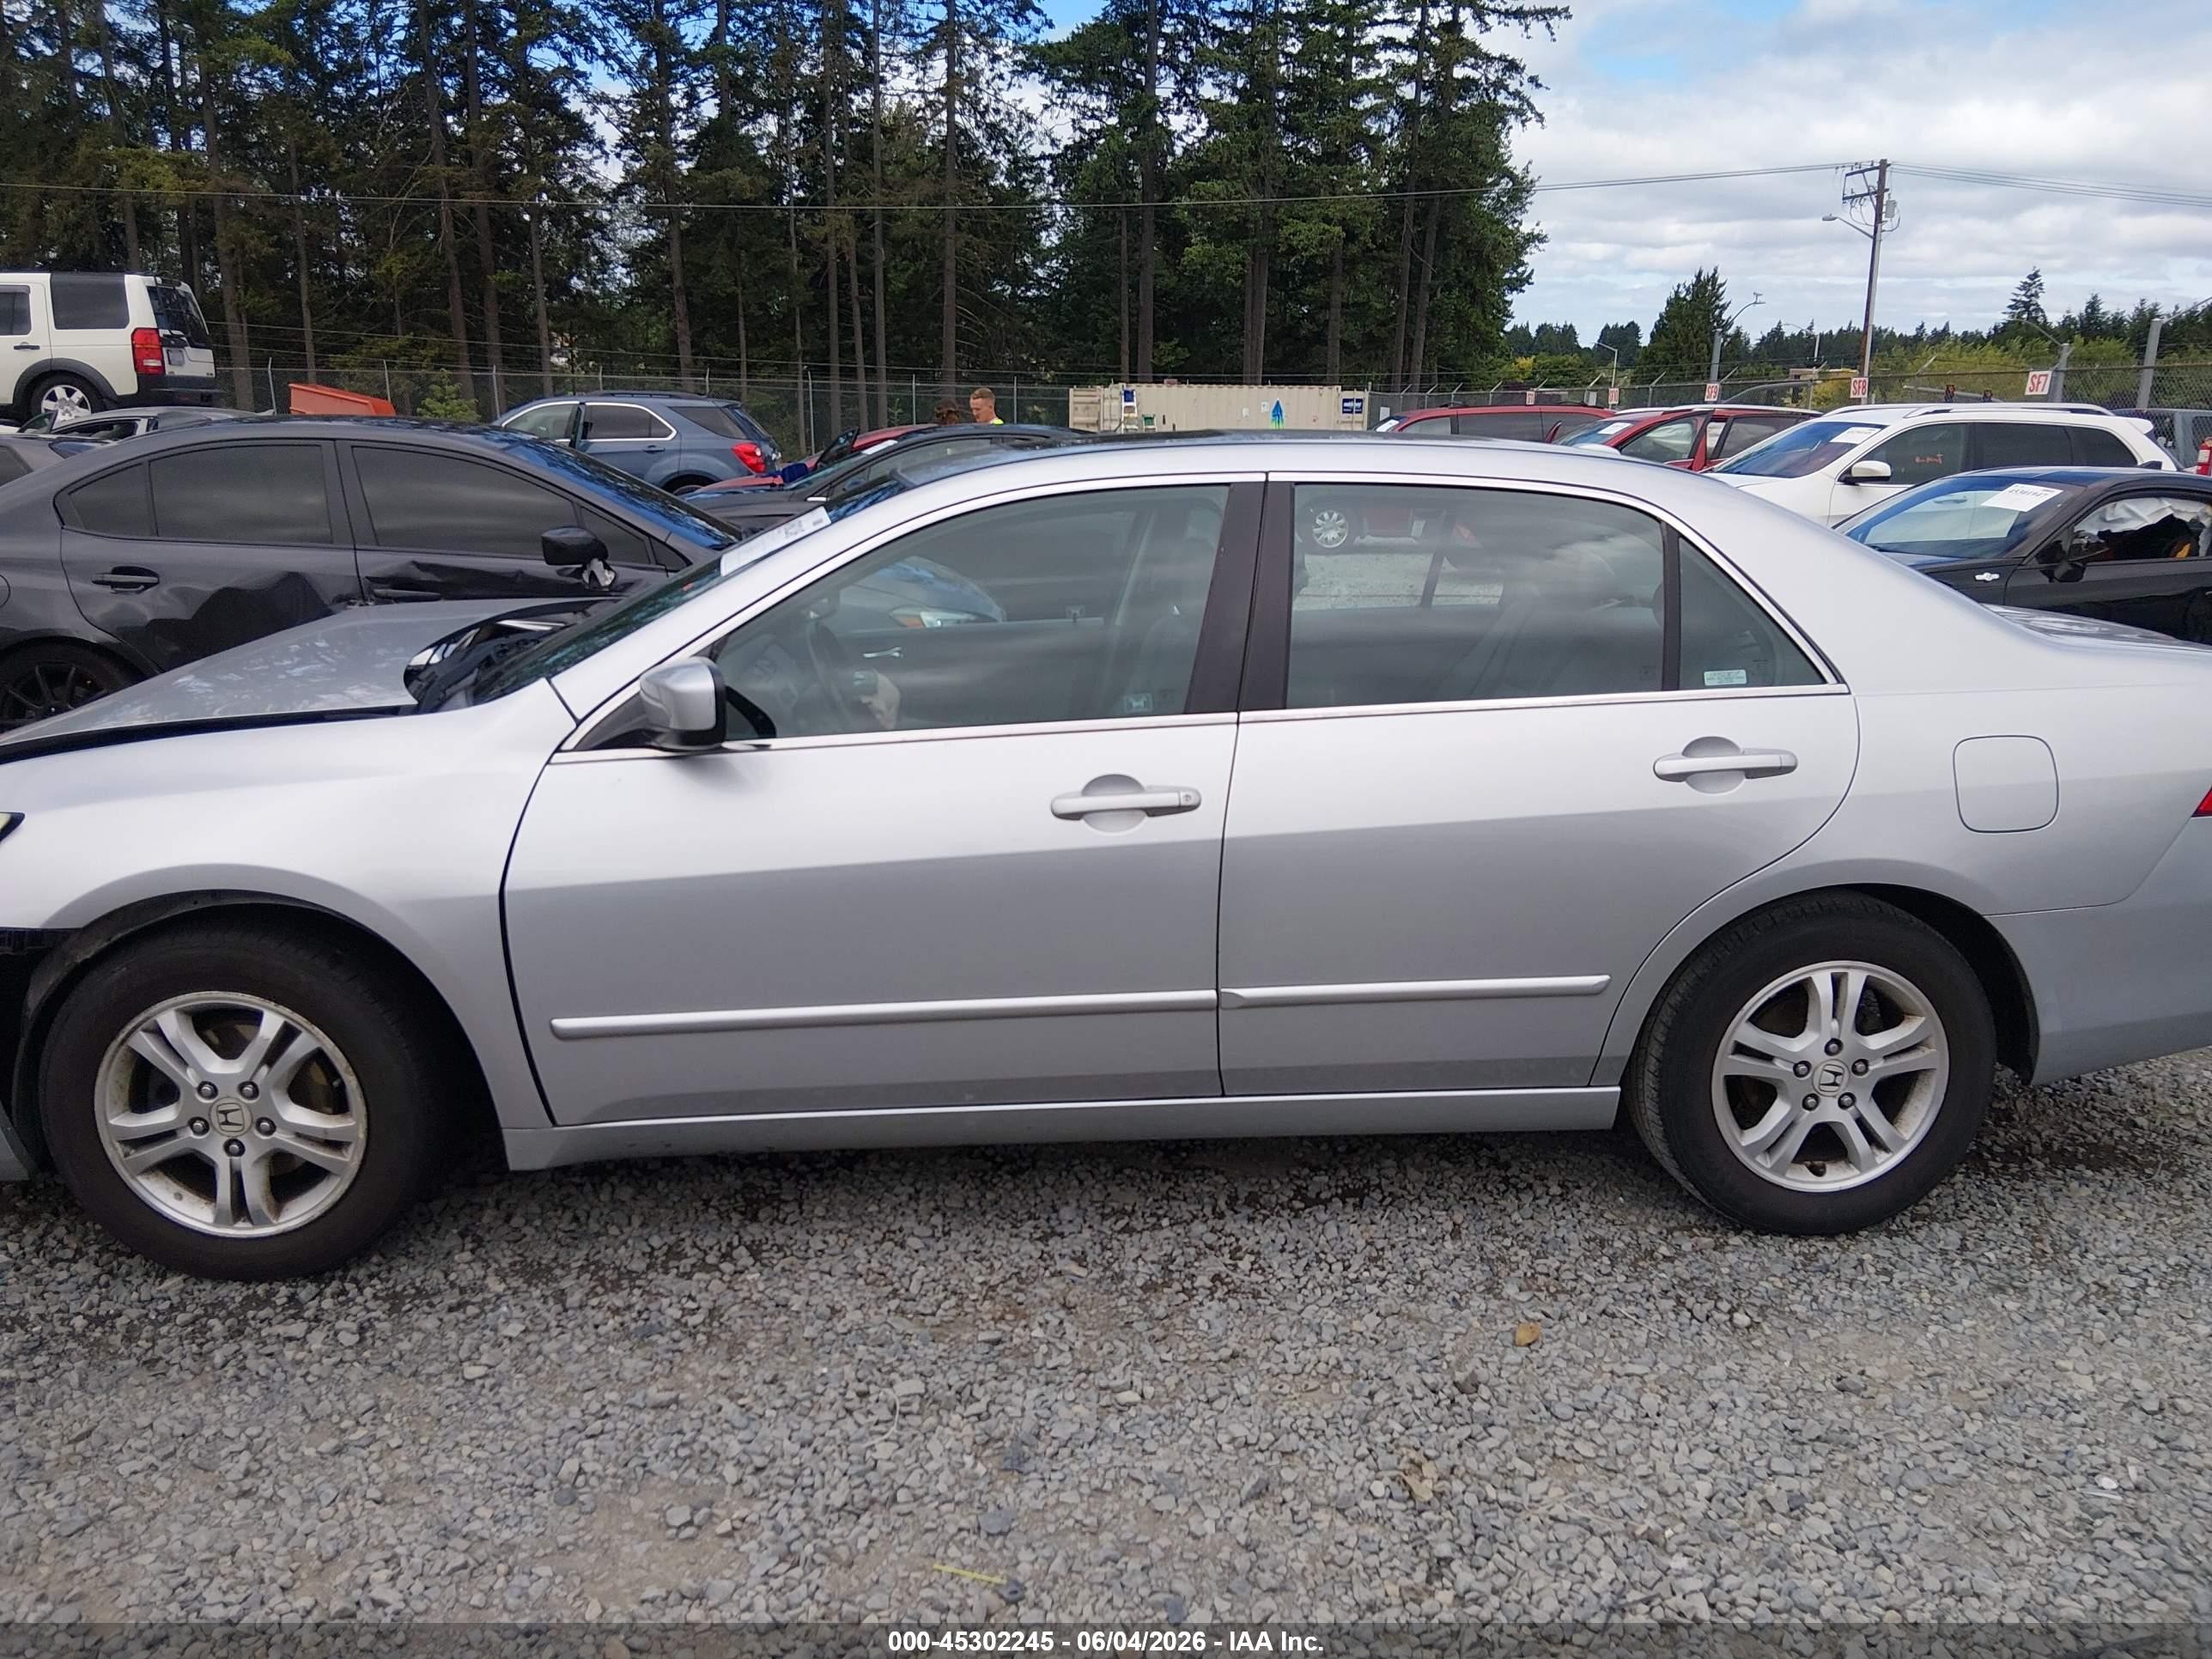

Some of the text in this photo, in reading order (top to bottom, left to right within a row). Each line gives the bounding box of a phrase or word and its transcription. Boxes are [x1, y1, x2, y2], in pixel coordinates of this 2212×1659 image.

[1852, 380, 1867, 396] SF8
[2028, 374, 2049, 392] SF7
[1706, 385, 1718, 399] SF9
